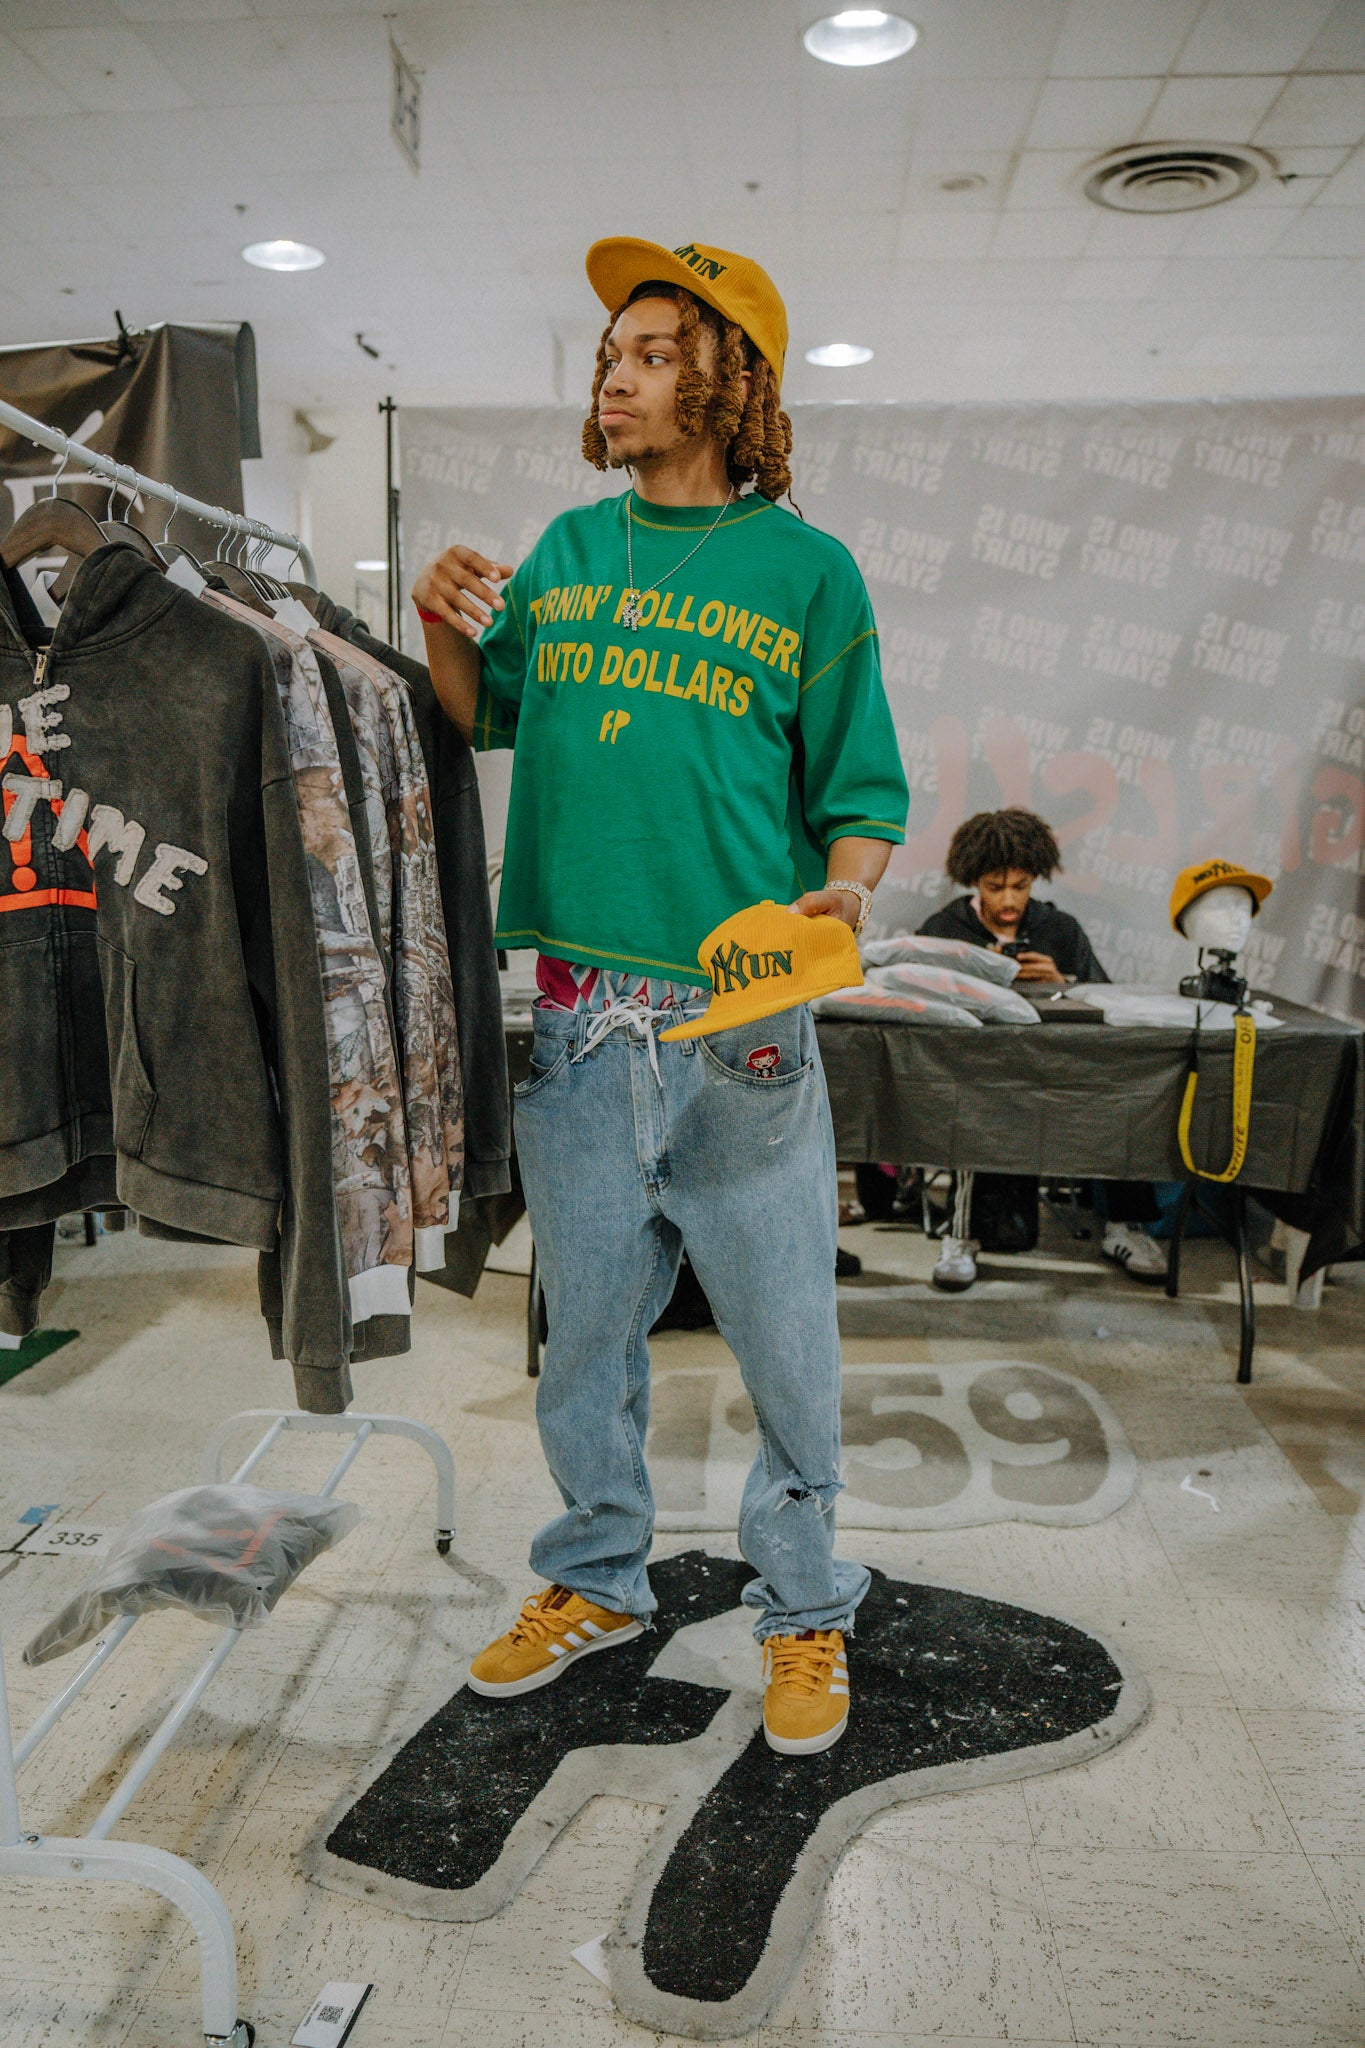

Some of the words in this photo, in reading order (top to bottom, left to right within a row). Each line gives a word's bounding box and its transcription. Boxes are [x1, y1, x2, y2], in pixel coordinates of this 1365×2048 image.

[530, 583, 613, 627] TRNIN'
[537, 643, 594, 683] INTO
[598, 645, 754, 717] DOLLARS
[2, 772, 208, 916] TIME
[48, 1531, 102, 1547] 335
